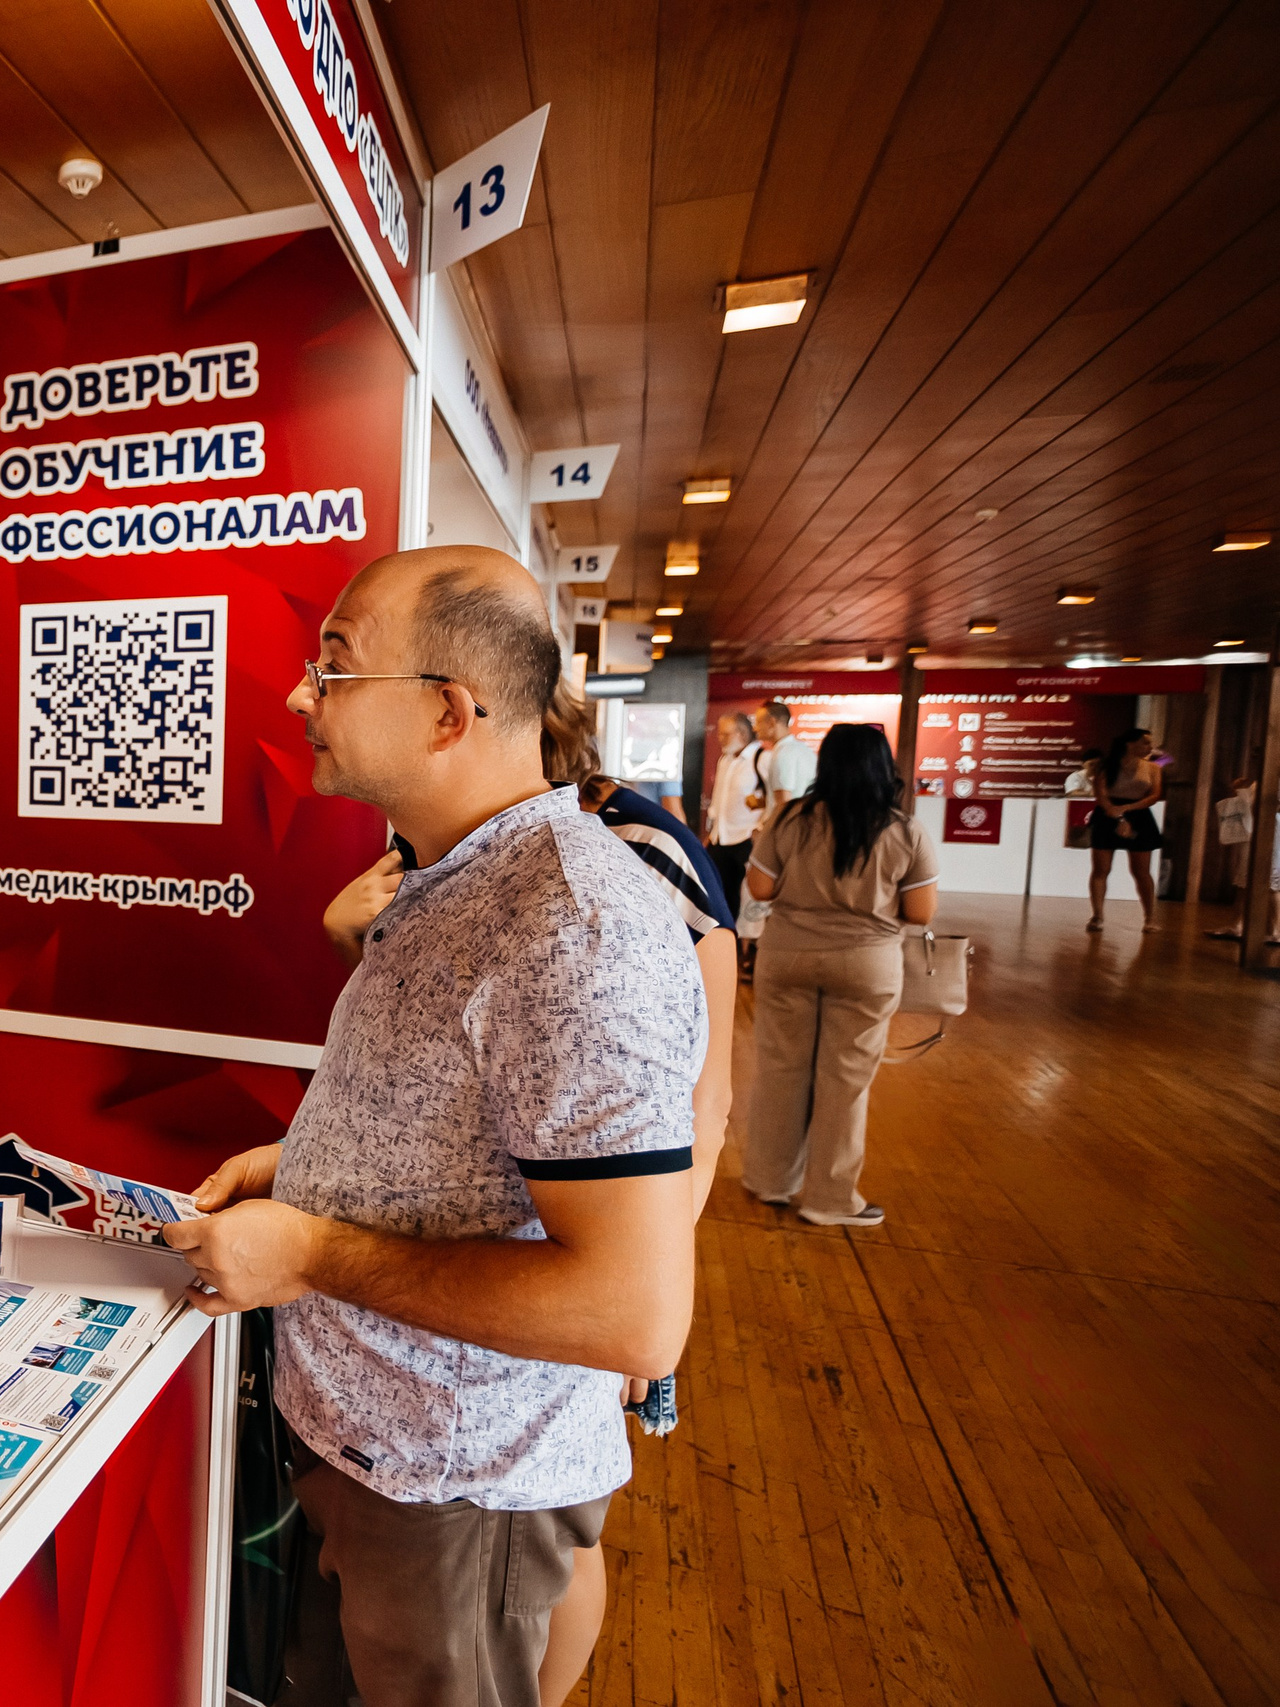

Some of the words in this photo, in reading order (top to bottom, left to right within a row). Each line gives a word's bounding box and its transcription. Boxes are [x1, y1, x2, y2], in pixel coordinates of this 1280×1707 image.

[453, 165, 505, 230] 13
[5, 350, 252, 424] ДОВЕРЬТЕ
[0, 431, 257, 490] ОБУЧЕНИЕ
[551, 462, 591, 487] 14
[572, 556, 599, 572] 15
[1017, 677, 1100, 686] ОРГКОМИТЕТ
